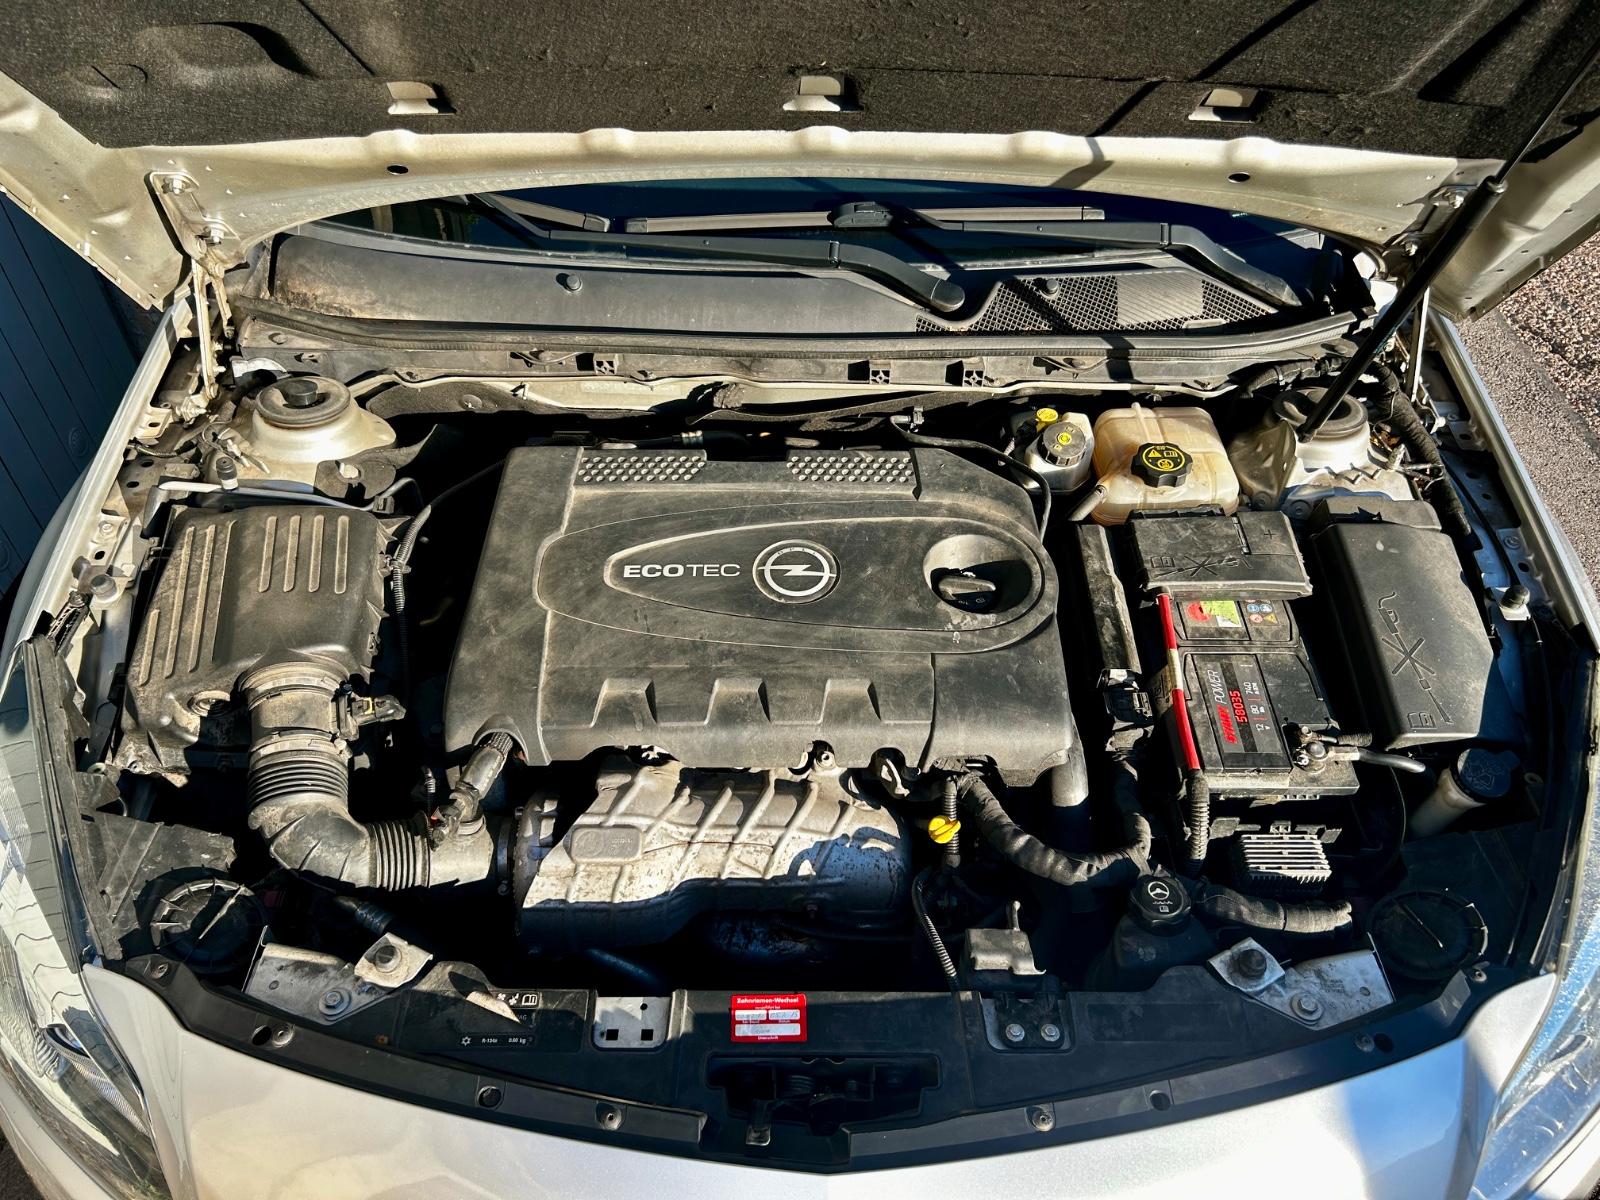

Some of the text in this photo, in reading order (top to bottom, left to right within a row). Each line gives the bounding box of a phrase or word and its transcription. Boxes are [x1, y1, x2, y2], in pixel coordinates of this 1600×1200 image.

[623, 564, 741, 578] ECOTEC
[1207, 669, 1227, 704] POWER
[1243, 681, 1254, 695] 740
[1229, 690, 1248, 723] 58035
